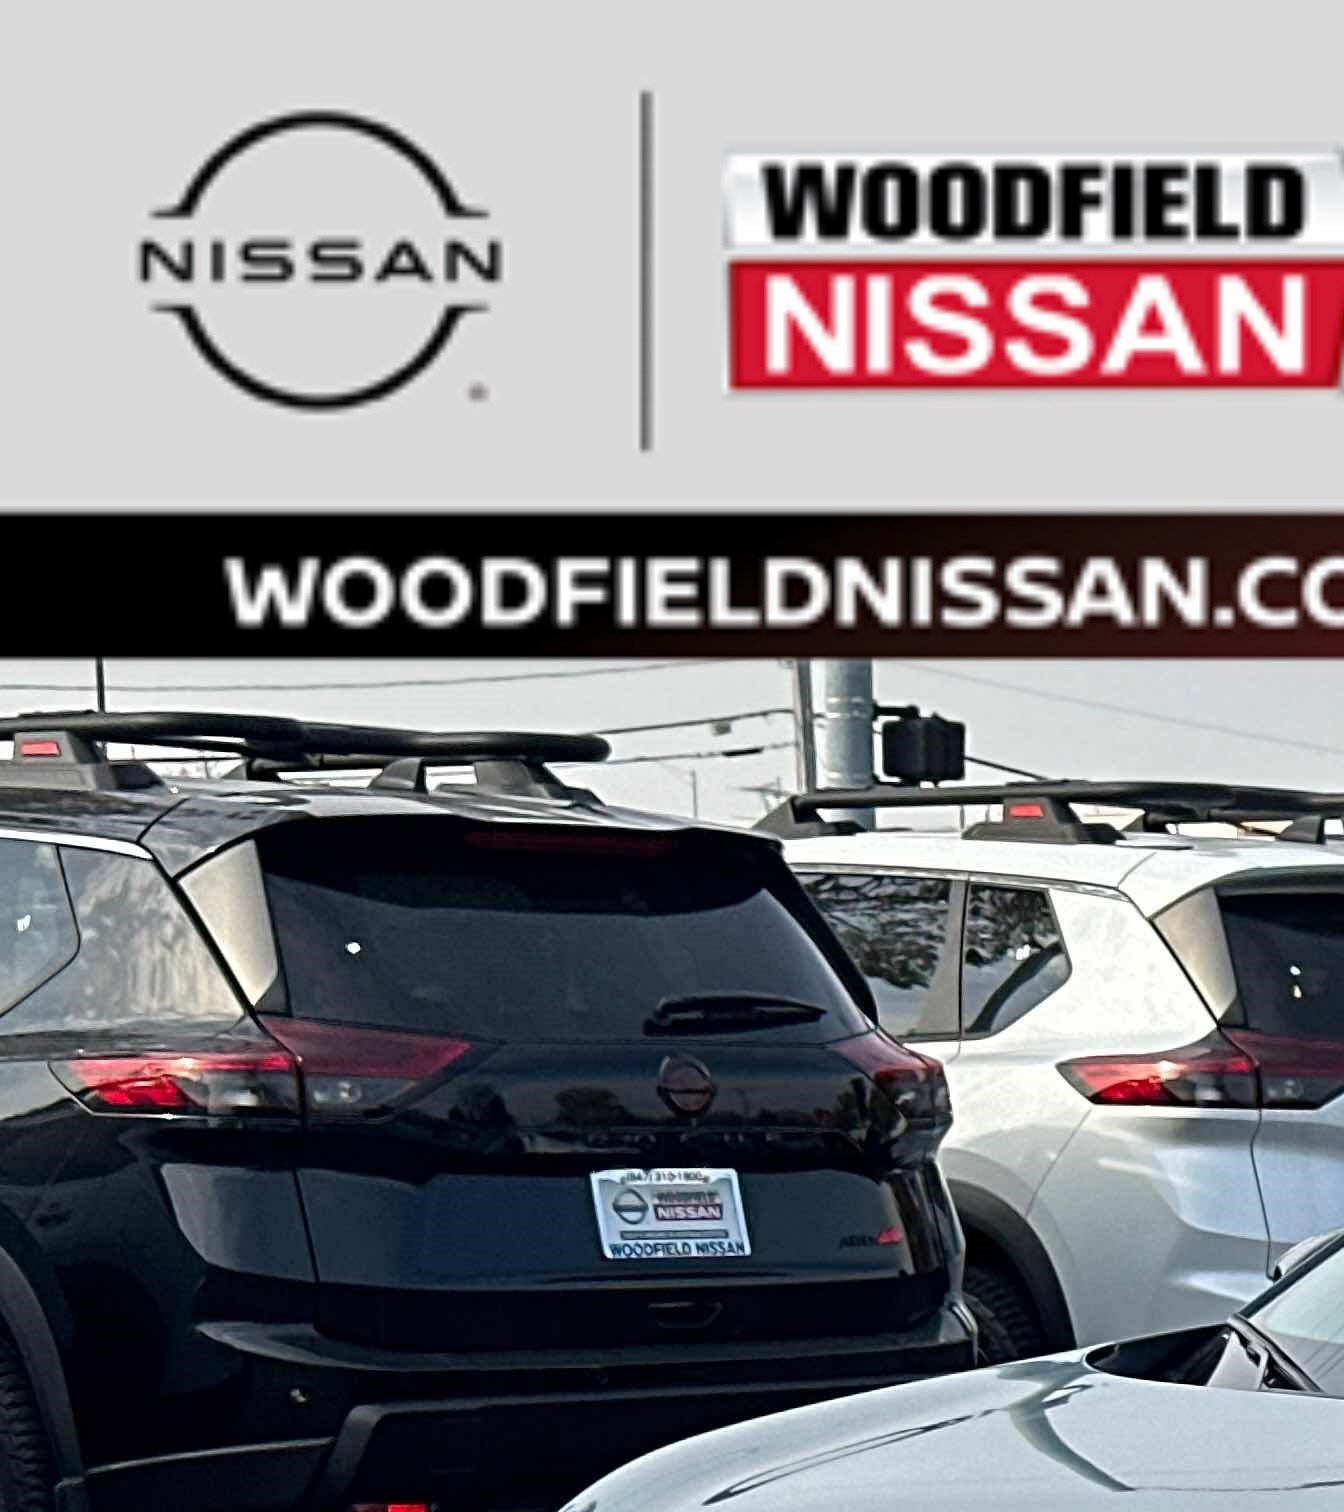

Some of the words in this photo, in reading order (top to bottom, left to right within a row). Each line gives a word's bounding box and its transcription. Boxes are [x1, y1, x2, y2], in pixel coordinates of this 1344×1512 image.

[656, 1205, 721, 1220] NISSAN
[609, 1242, 692, 1258] WOODFIELD
[694, 1240, 745, 1255] NISSAN
